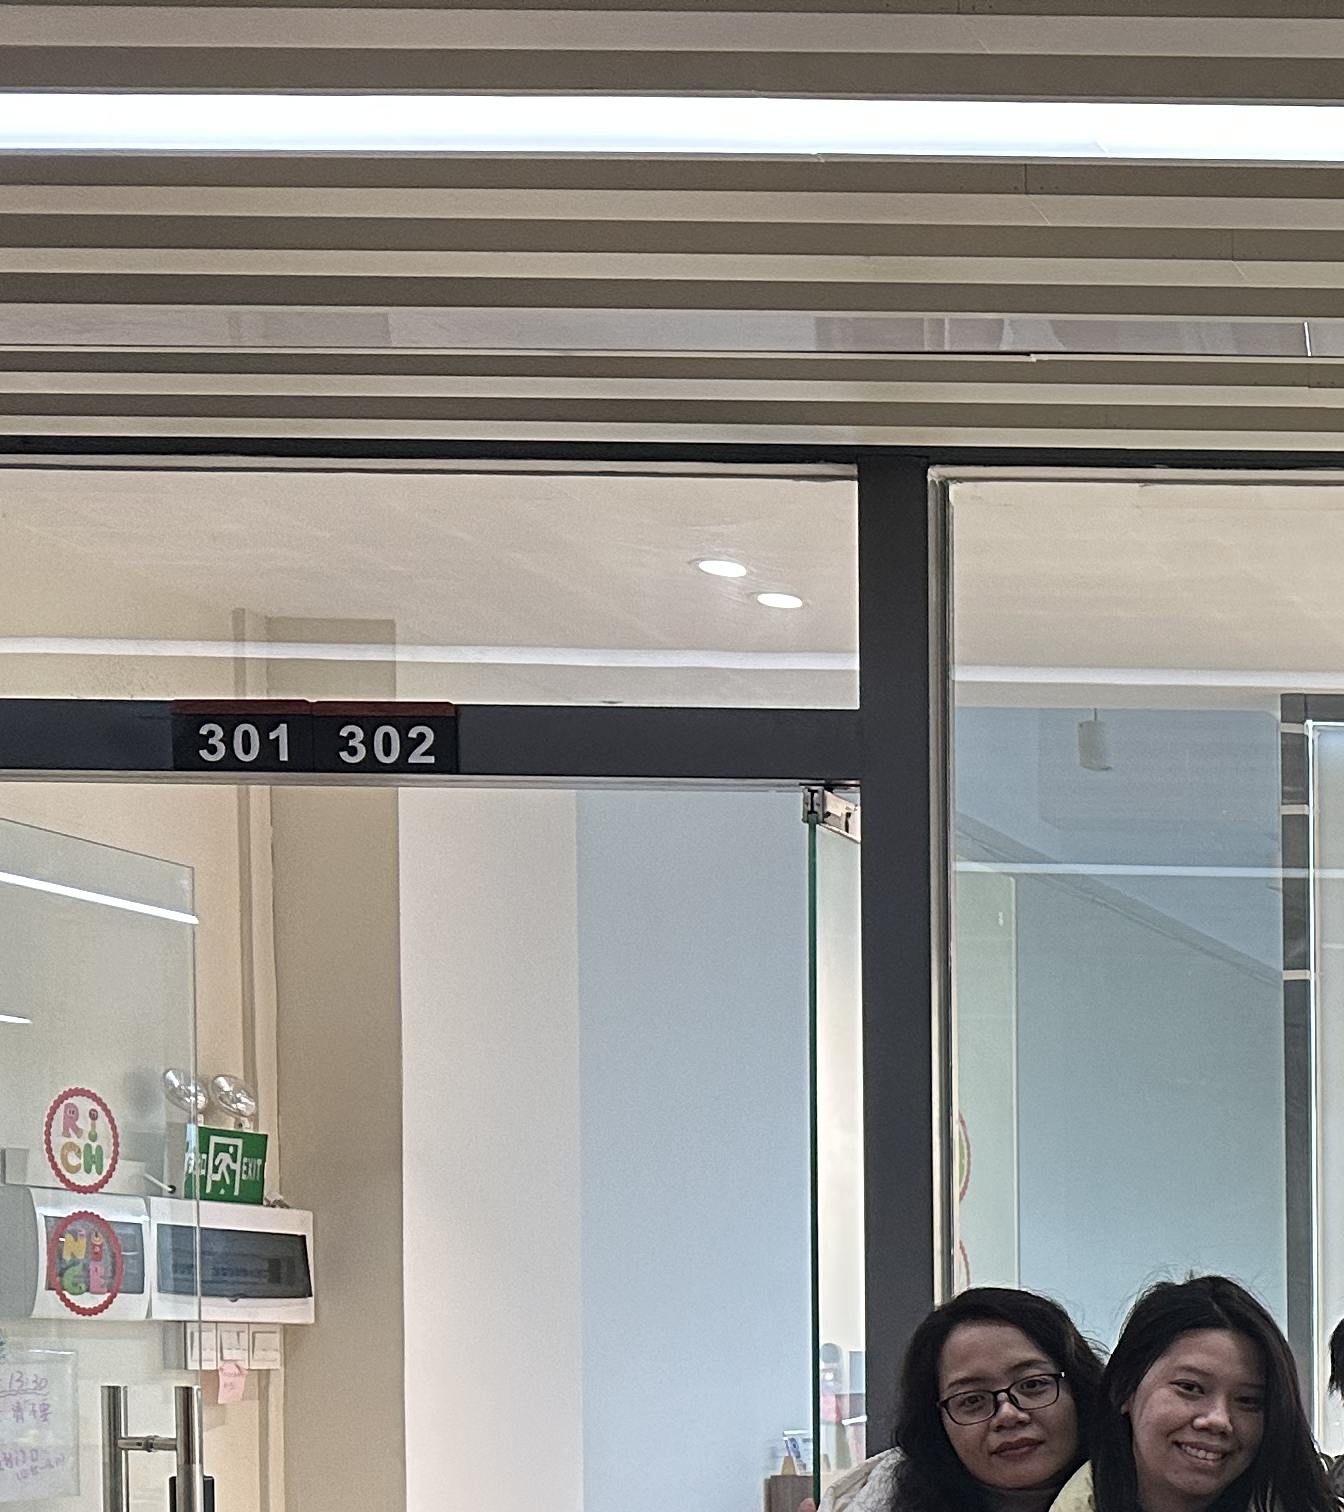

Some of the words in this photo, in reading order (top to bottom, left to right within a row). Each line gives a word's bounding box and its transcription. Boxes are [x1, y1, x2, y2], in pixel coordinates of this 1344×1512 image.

[198, 723, 289, 762] 301
[339, 725, 436, 764] 302
[242, 1157, 262, 1180] EXIT
